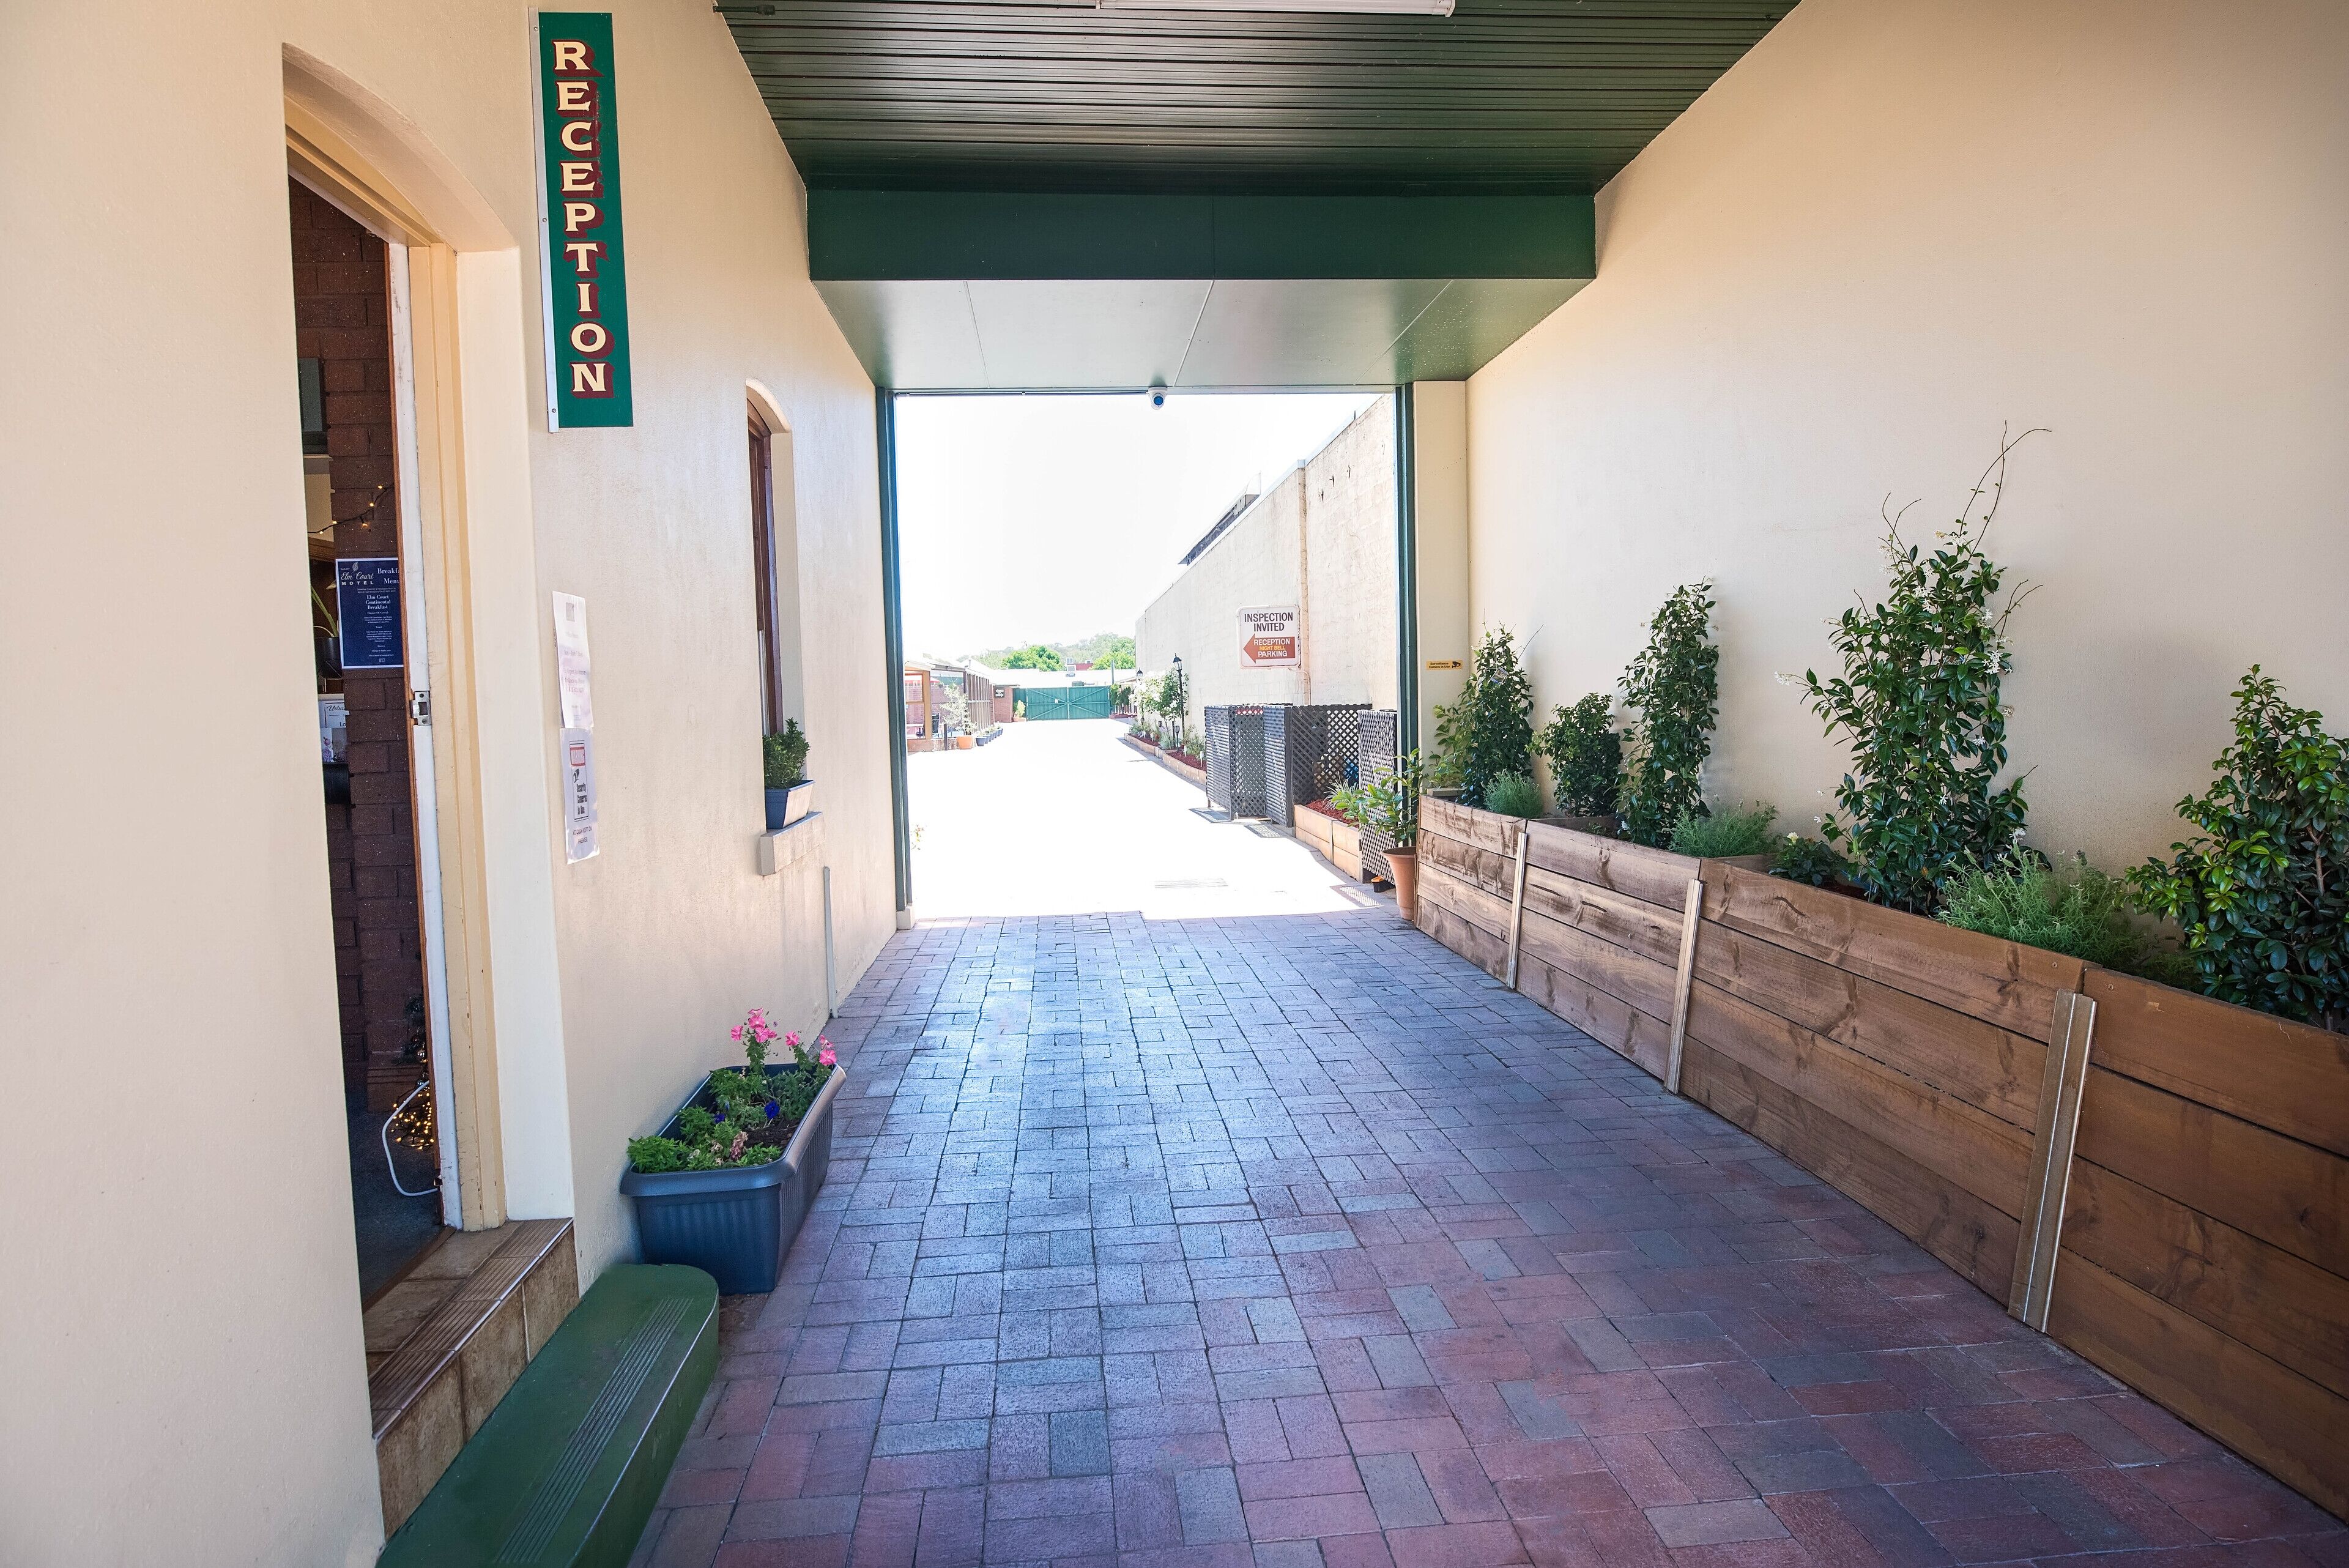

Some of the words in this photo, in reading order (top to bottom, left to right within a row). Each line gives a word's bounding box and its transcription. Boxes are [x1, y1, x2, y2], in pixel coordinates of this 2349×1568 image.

[552, 39, 612, 395] RECEPTION
[341, 571, 353, 581] Elm
[356, 571, 374, 580] Court
[1244, 612, 1293, 622] INSPECTION
[1253, 622, 1285, 632] INVITED
